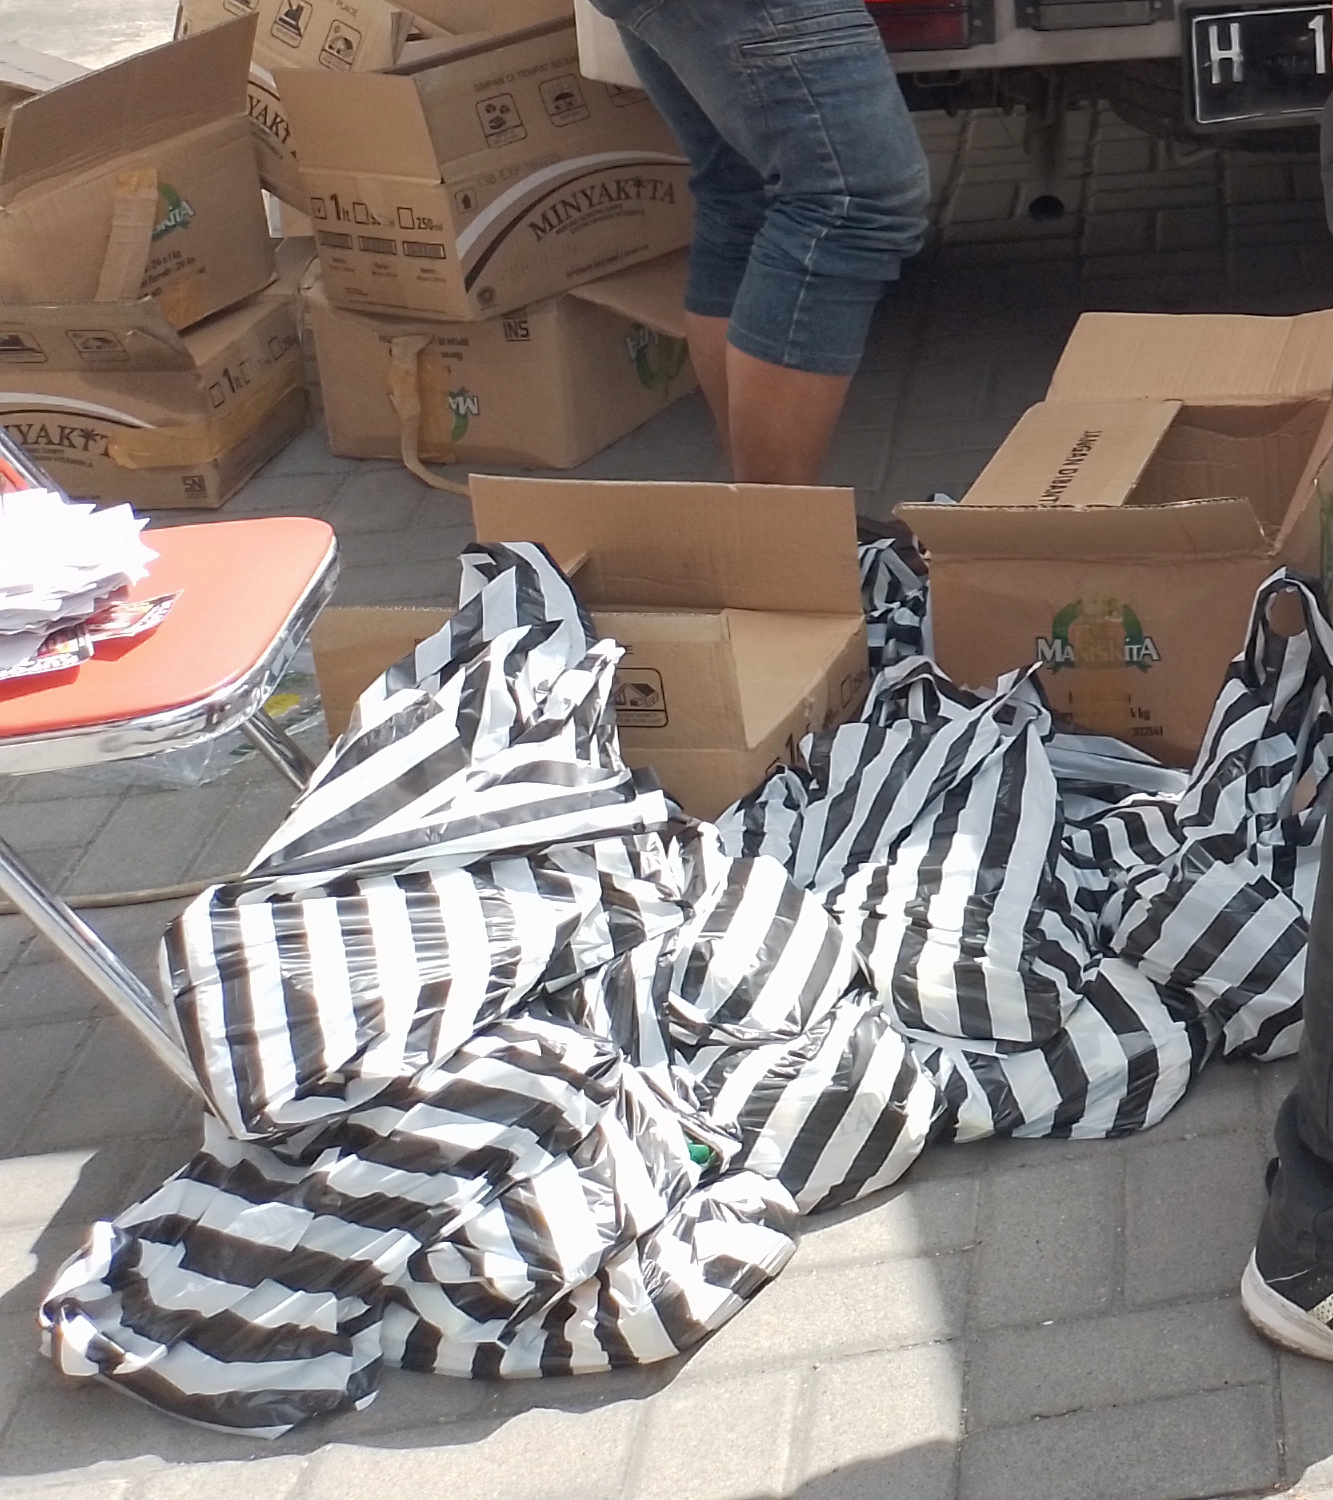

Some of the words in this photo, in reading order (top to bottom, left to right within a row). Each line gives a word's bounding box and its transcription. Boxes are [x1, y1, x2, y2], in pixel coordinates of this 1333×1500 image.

[1208, 21, 1244, 85] H
[527, 176, 677, 242] MINYAKITA
[1063, 430, 1103, 472] JANGAN
[1038, 465, 1078, 505] DIBANT
